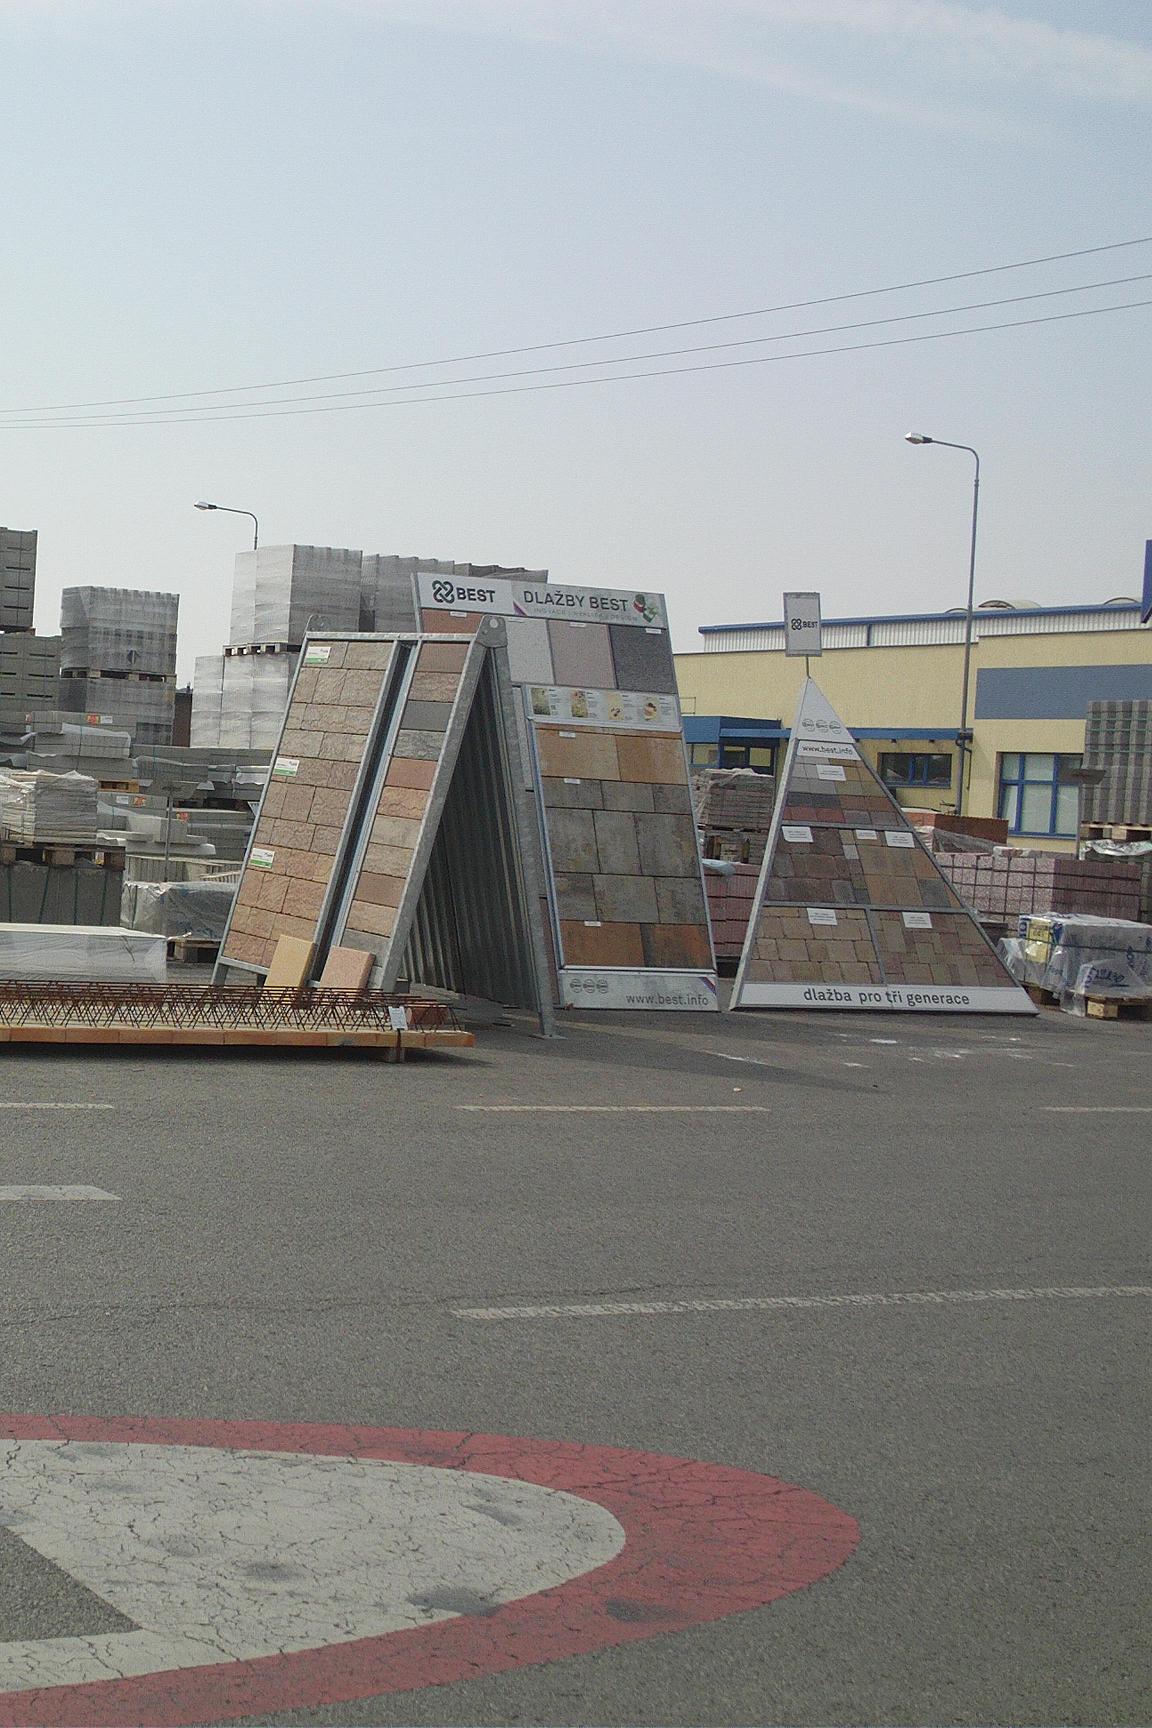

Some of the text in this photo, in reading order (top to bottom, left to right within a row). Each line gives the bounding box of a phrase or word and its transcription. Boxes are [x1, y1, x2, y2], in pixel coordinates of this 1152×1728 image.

[456, 587, 496, 603] BEST
[523, 590, 628, 611] DLAŽBY BEST
[803, 621, 818, 629] BEST
[802, 745, 853, 755] www.best.info
[626, 993, 709, 1006] www.best.info
[803, 988, 969, 1006] dlažba pro tři generace
